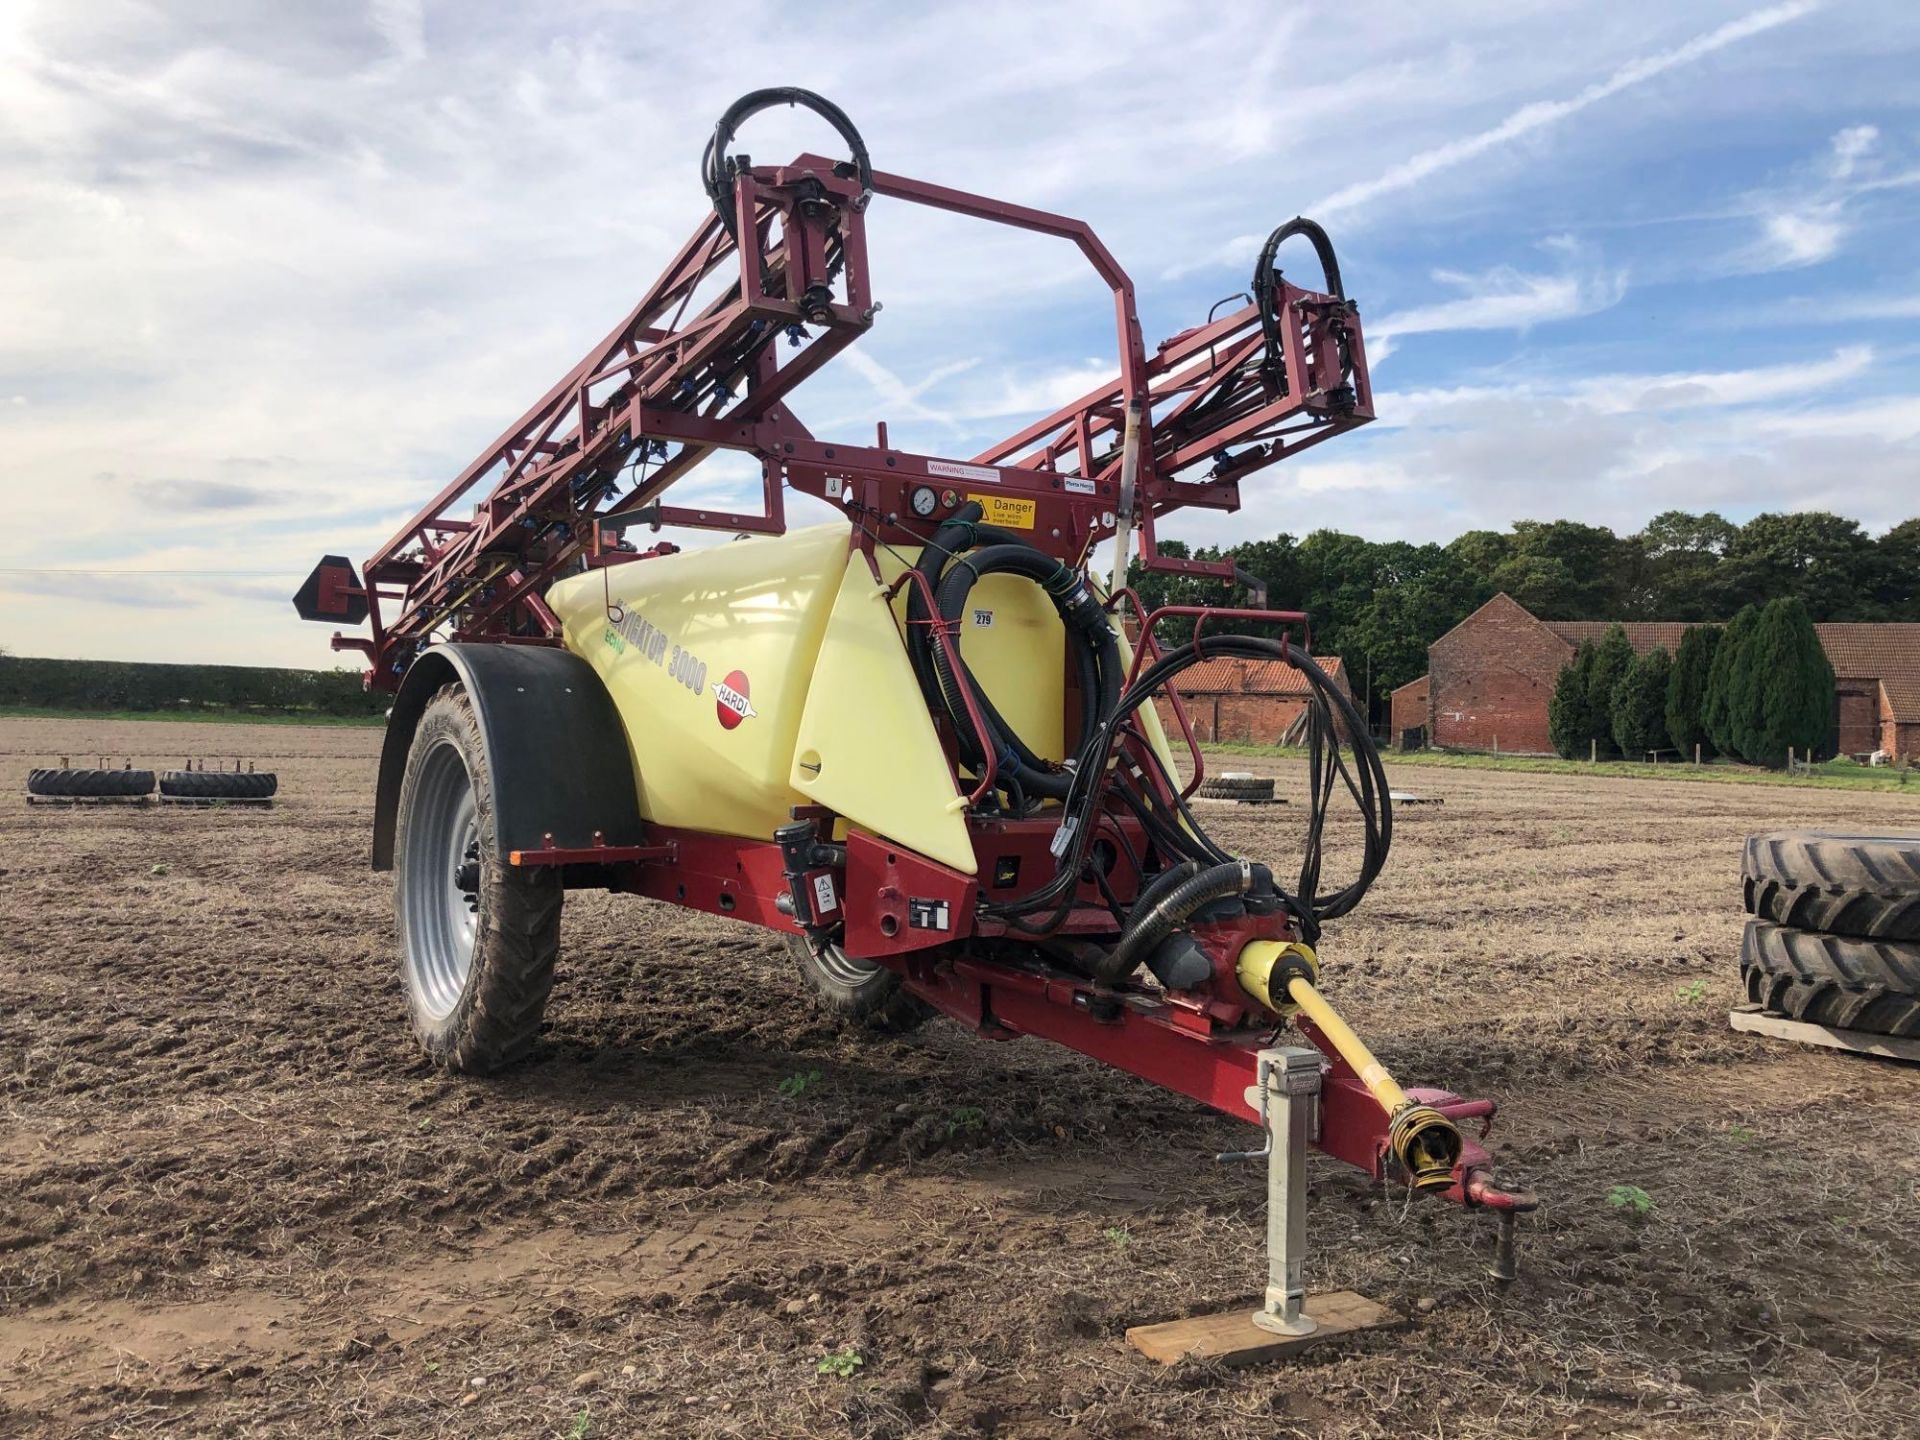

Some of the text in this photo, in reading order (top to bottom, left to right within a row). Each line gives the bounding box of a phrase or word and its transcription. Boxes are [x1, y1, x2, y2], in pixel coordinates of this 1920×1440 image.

[929, 463, 965, 475] WARNING
[994, 499, 1033, 513] Danger
[976, 614, 991, 625] 279
[668, 644, 708, 696] 3000
[718, 685, 749, 715] HARDI
